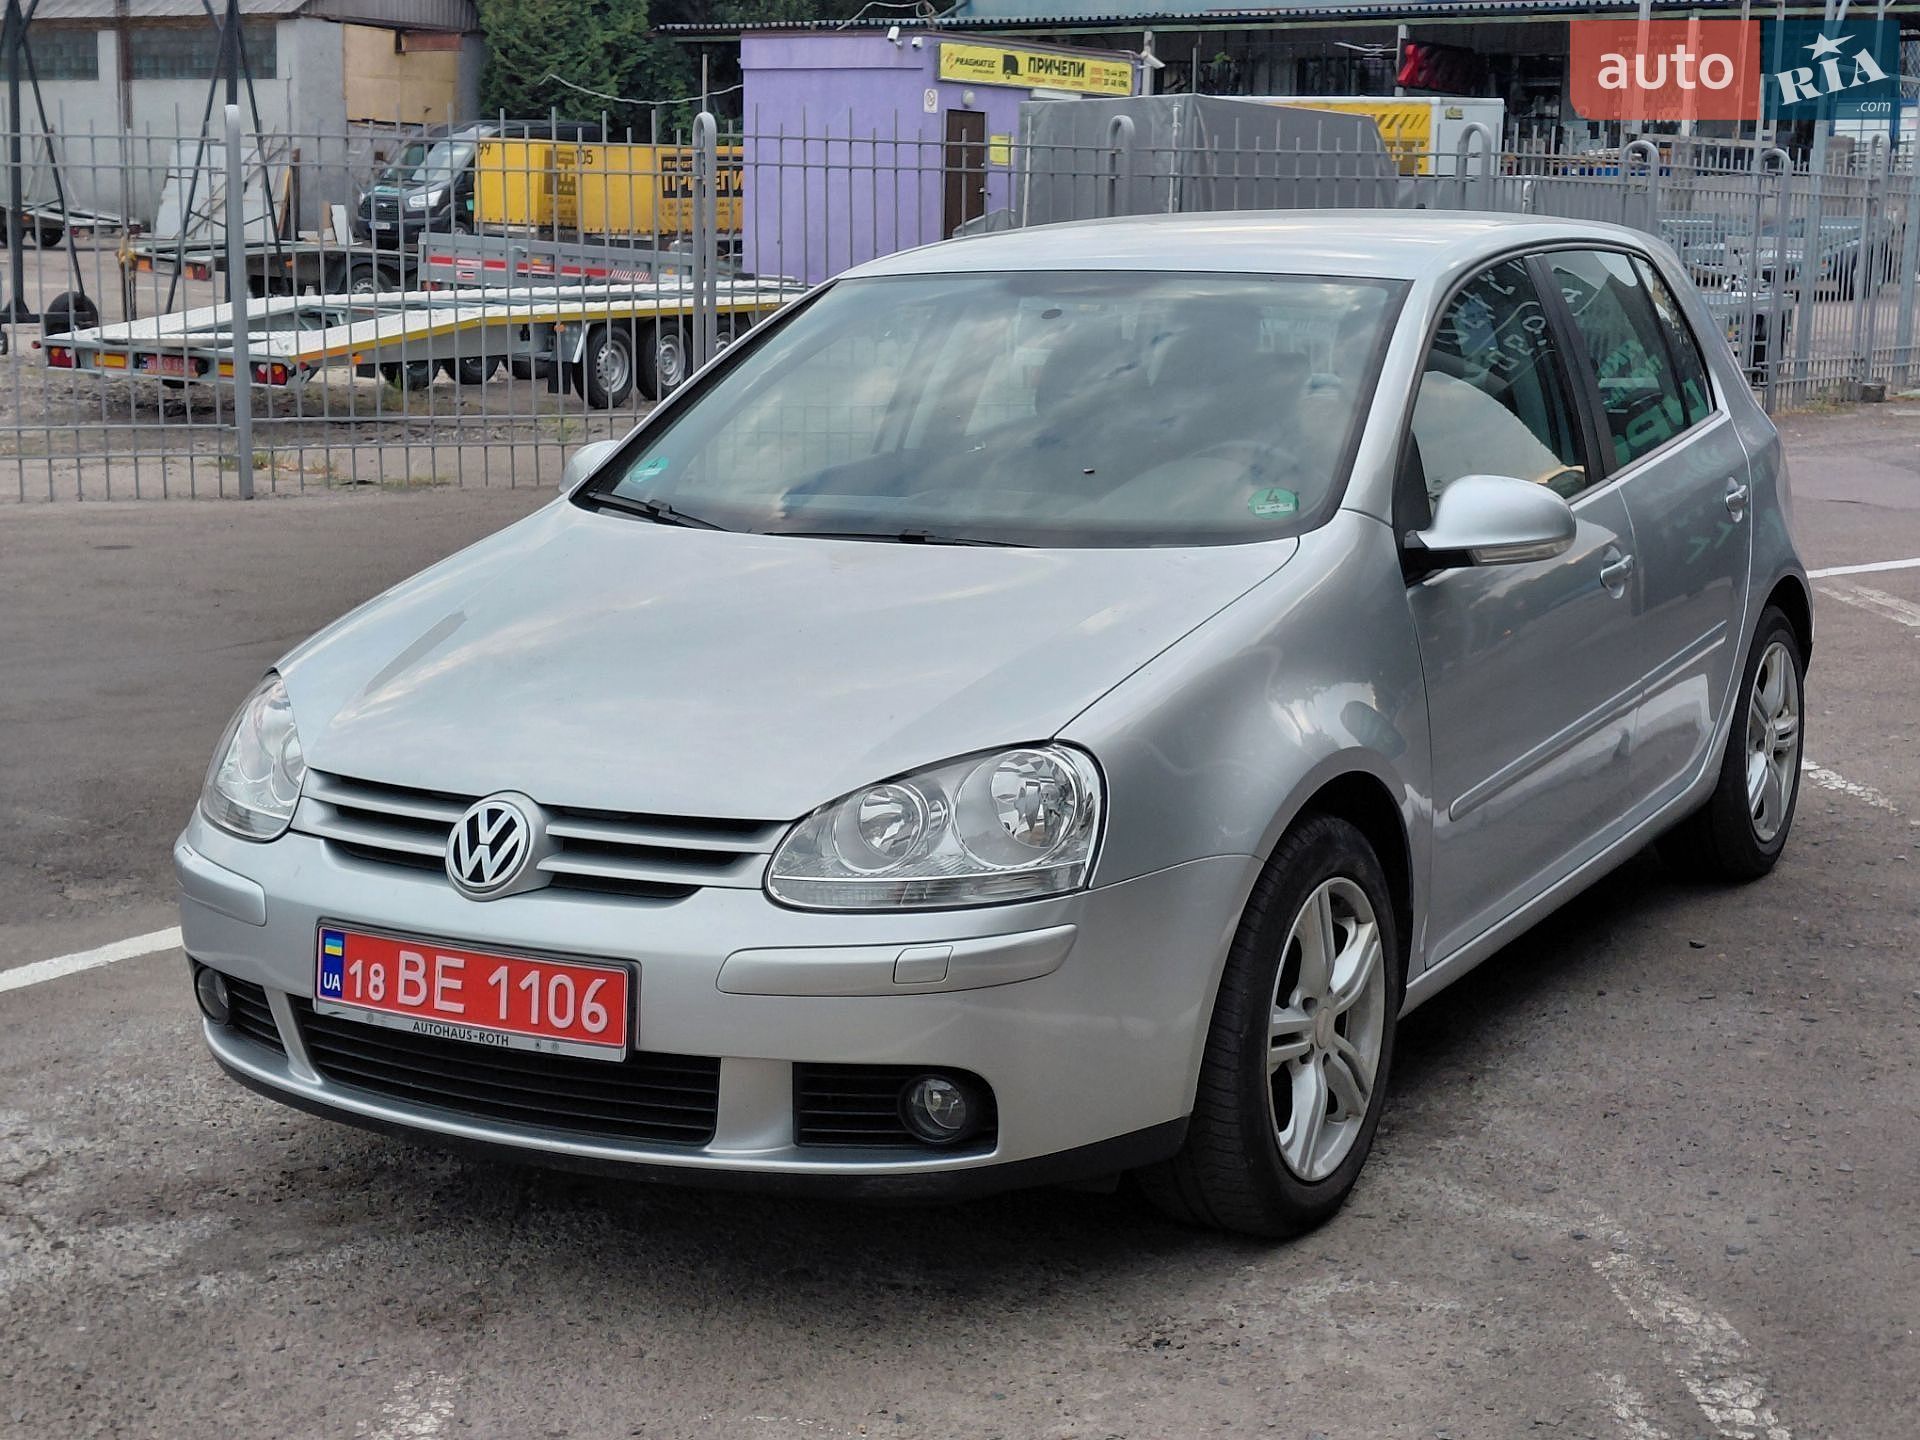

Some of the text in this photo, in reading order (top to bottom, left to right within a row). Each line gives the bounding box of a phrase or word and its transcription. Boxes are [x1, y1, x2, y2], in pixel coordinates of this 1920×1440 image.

[1028, 56, 1086, 78] ПРИЧЕПИ
[323, 971, 341, 991] UA
[349, 950, 608, 1034] 18 BE 1106
[412, 1021, 509, 1046] AUTOHAUS-ROTH
